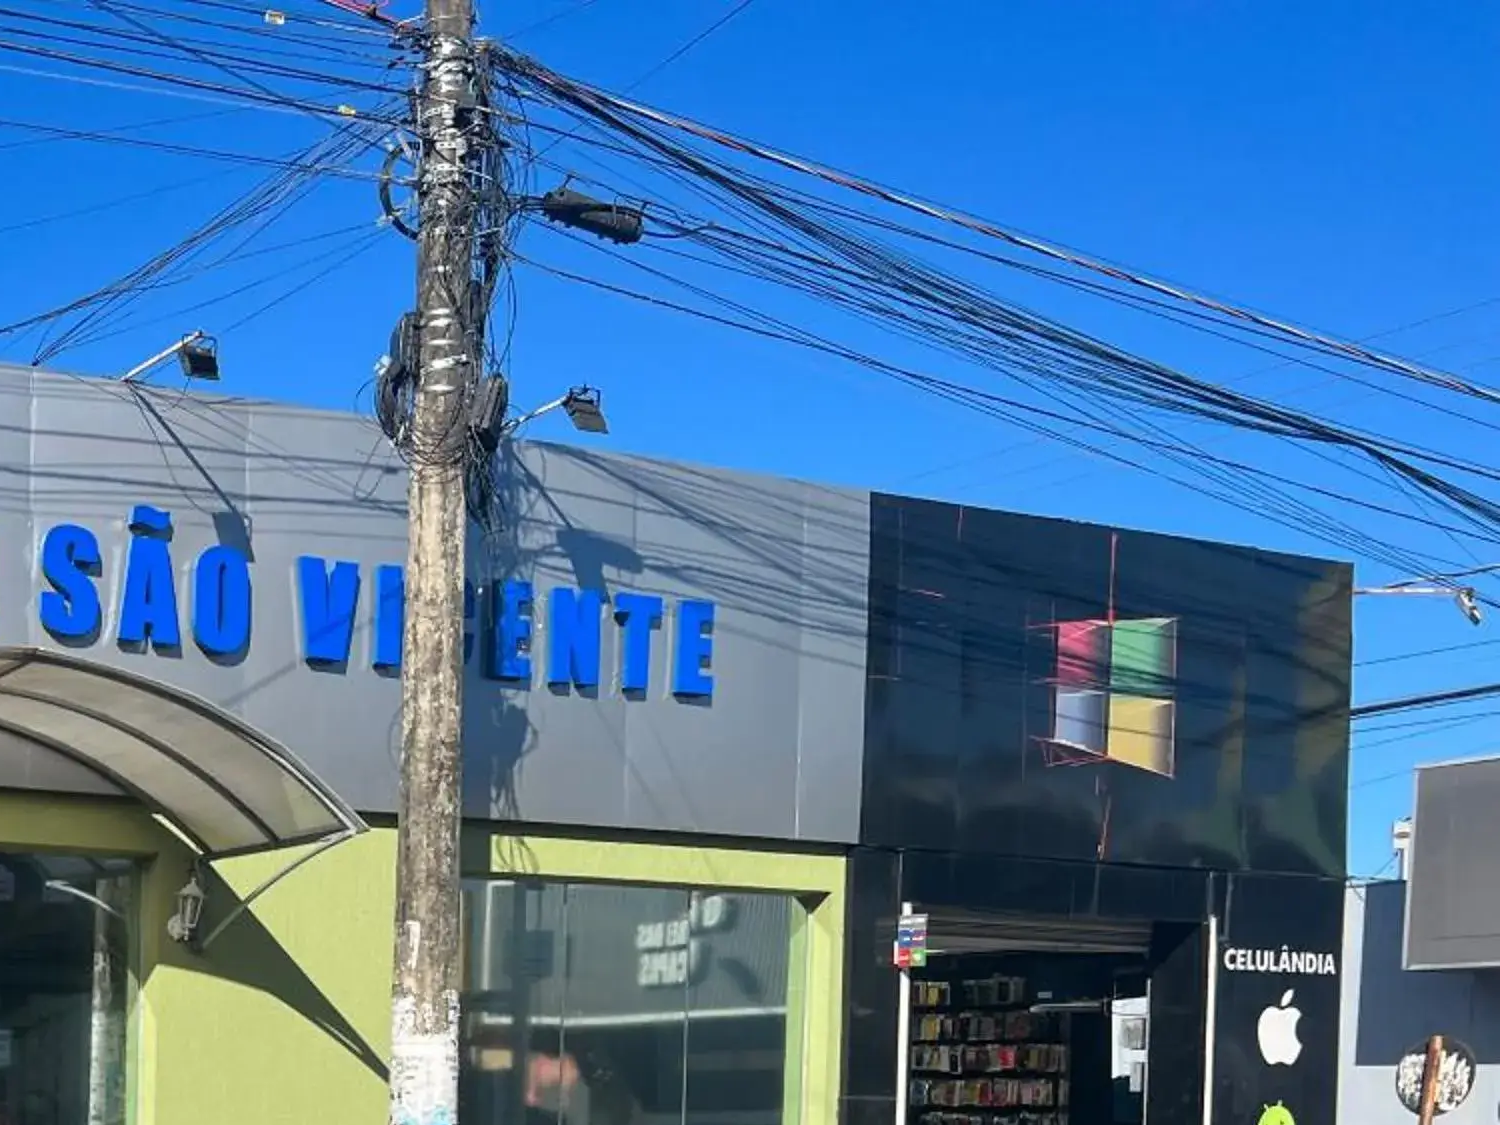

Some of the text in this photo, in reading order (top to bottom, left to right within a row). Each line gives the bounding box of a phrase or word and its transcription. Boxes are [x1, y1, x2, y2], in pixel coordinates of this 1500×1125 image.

[39, 504, 252, 654] SÃO
[295, 555, 715, 698] VIENTE
[1223, 944, 1336, 975] CELULÂNDIA
